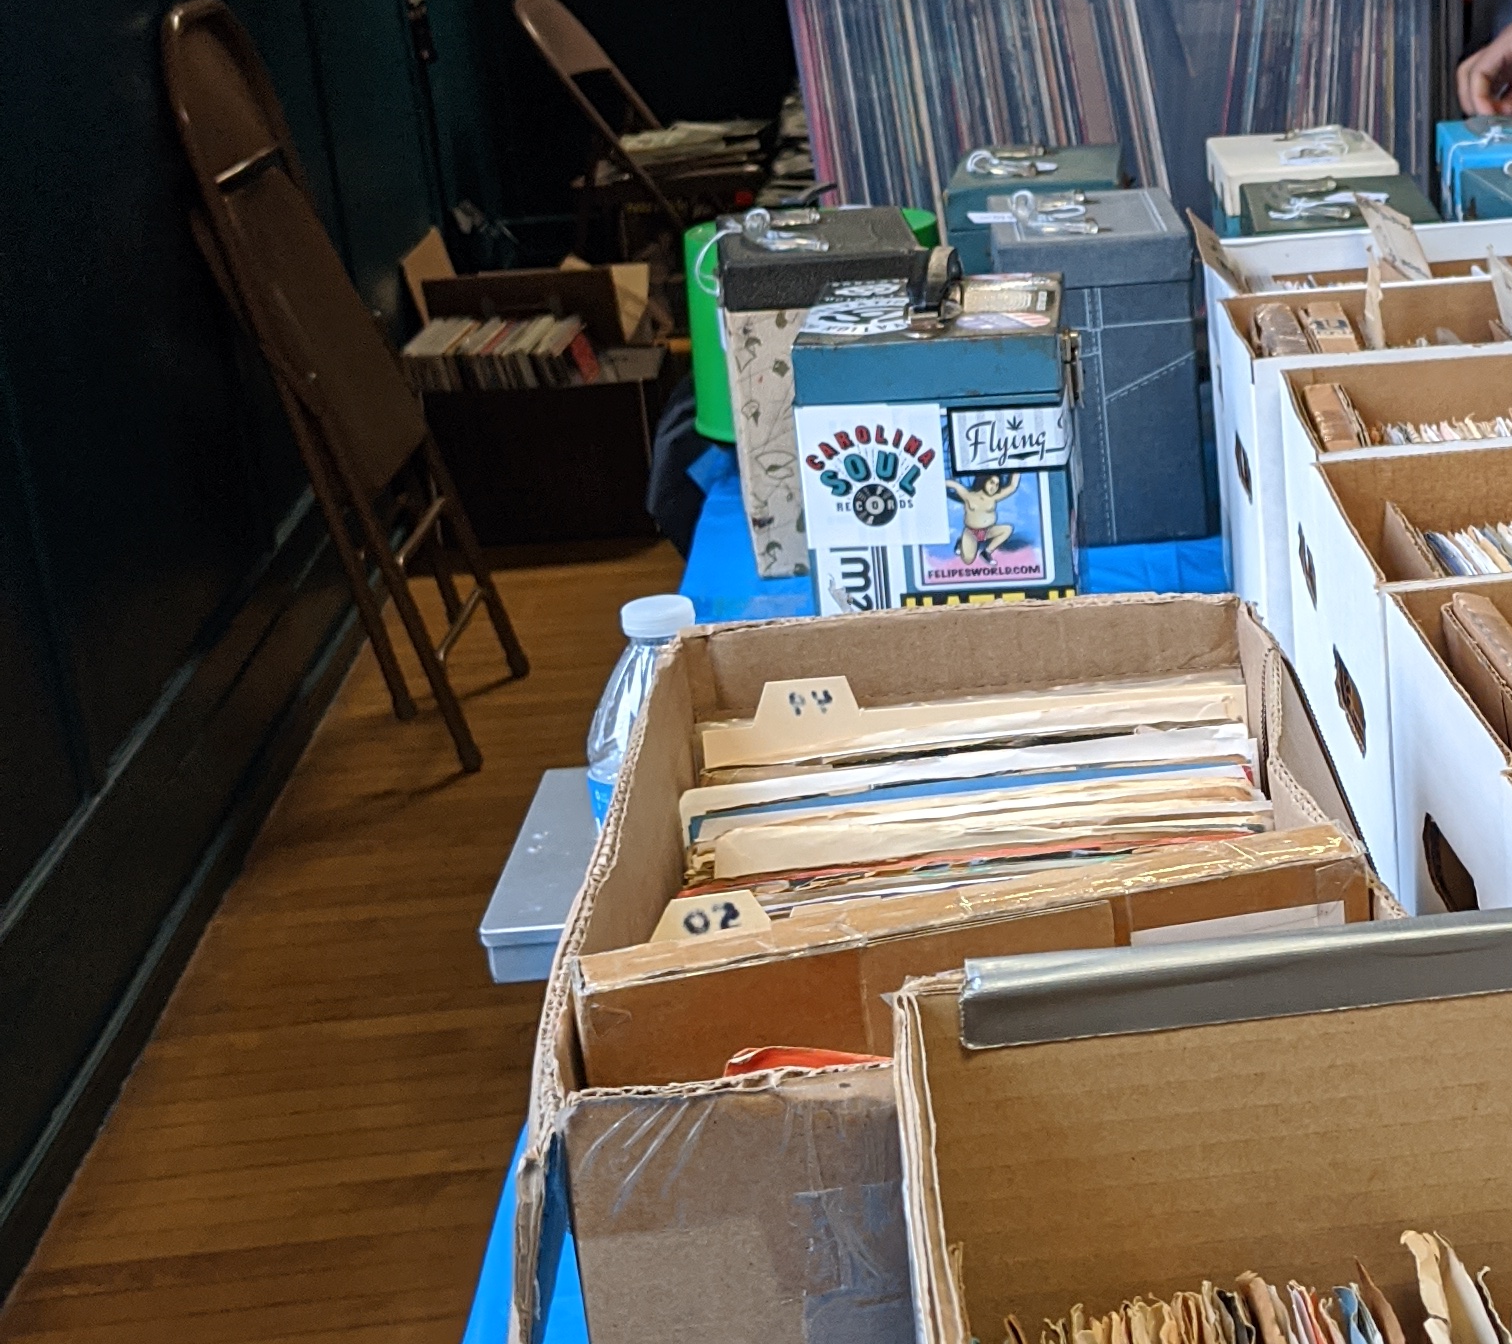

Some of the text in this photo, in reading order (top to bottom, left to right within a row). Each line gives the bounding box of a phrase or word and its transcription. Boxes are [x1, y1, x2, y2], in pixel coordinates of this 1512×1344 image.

[806, 424, 936, 471] CAROLINA
[965, 420, 1046, 466] Flying
[820, 450, 921, 498] SOUL
[837, 498, 914, 512] RECORDS
[927, 564, 1041, 579] FELIPESWORLD.COM
